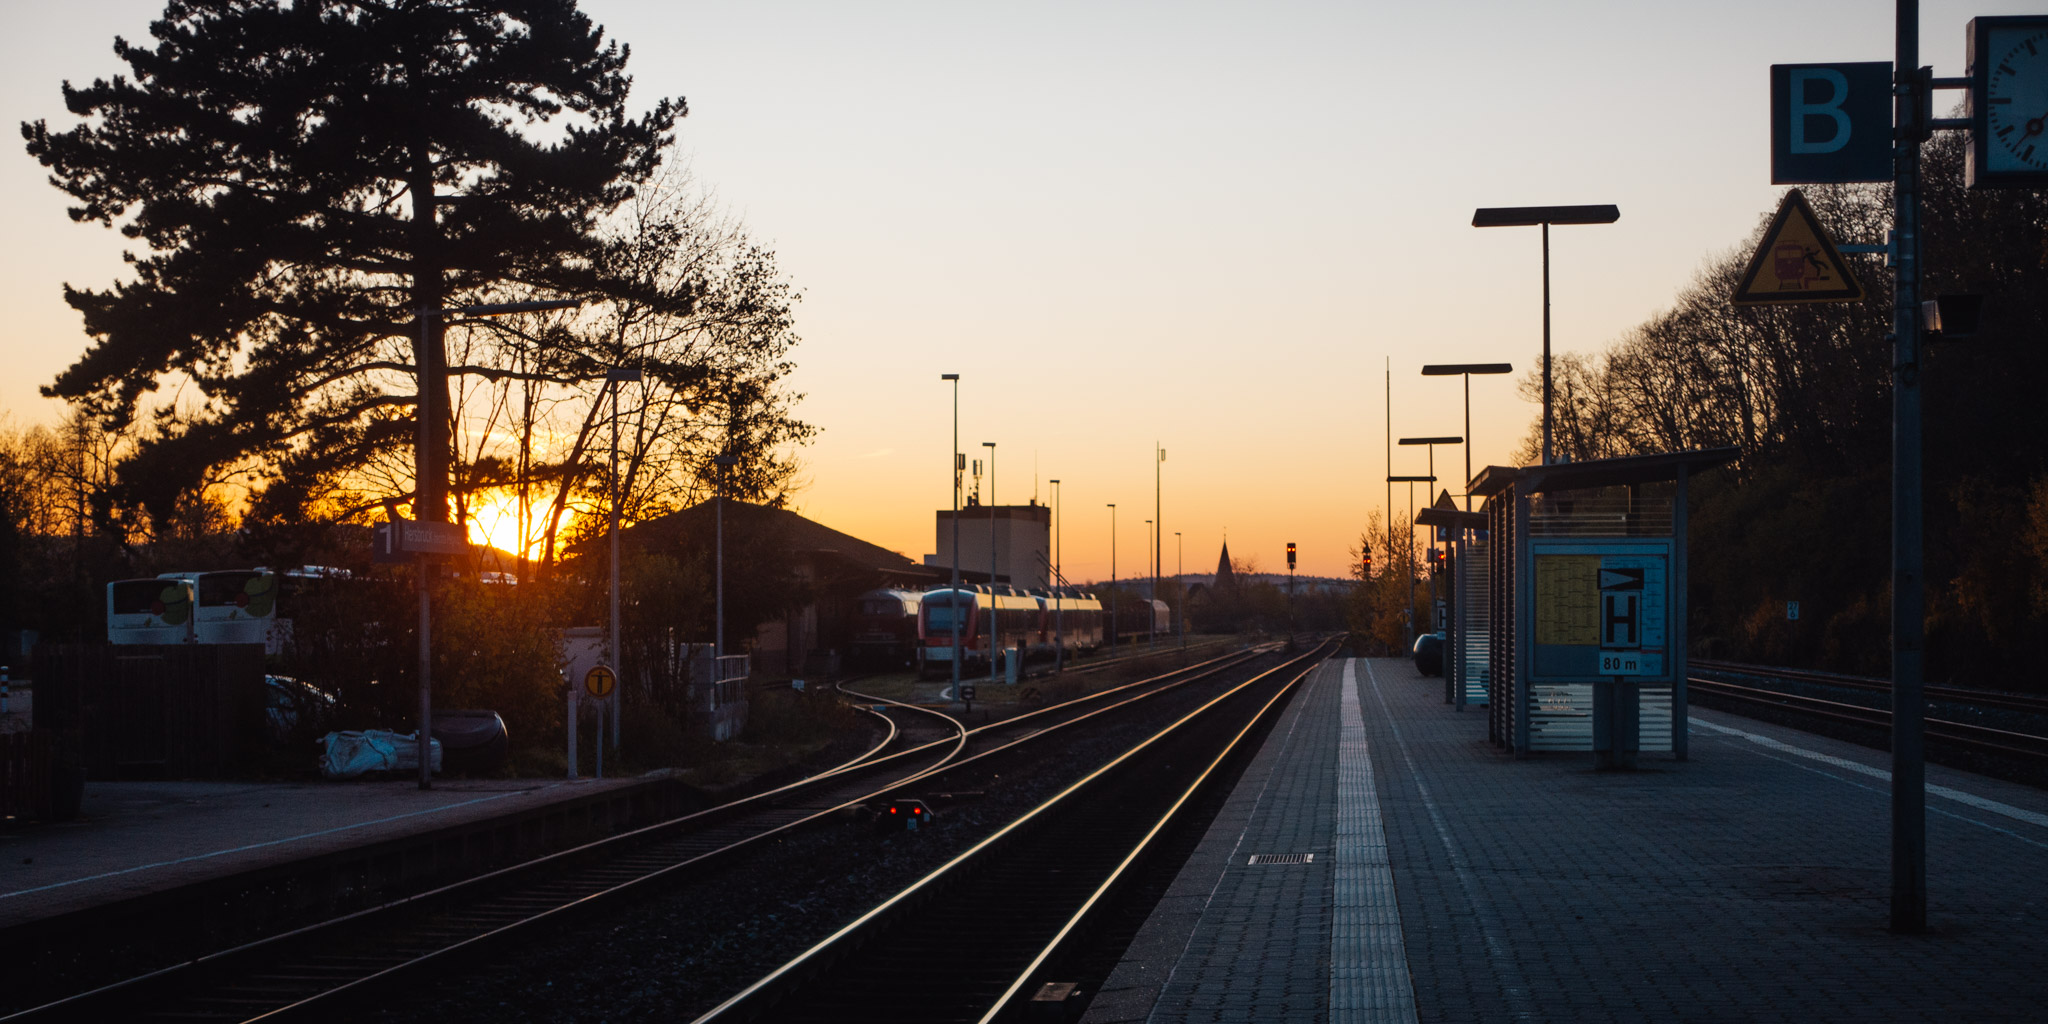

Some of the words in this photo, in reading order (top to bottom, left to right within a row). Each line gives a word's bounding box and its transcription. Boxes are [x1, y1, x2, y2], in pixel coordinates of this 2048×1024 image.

[1789, 67, 1852, 155] B
[380, 524, 391, 554] 1
[1606, 596, 1636, 643] H
[1604, 658, 1620, 670] 80
[1626, 662, 1636, 670] m
